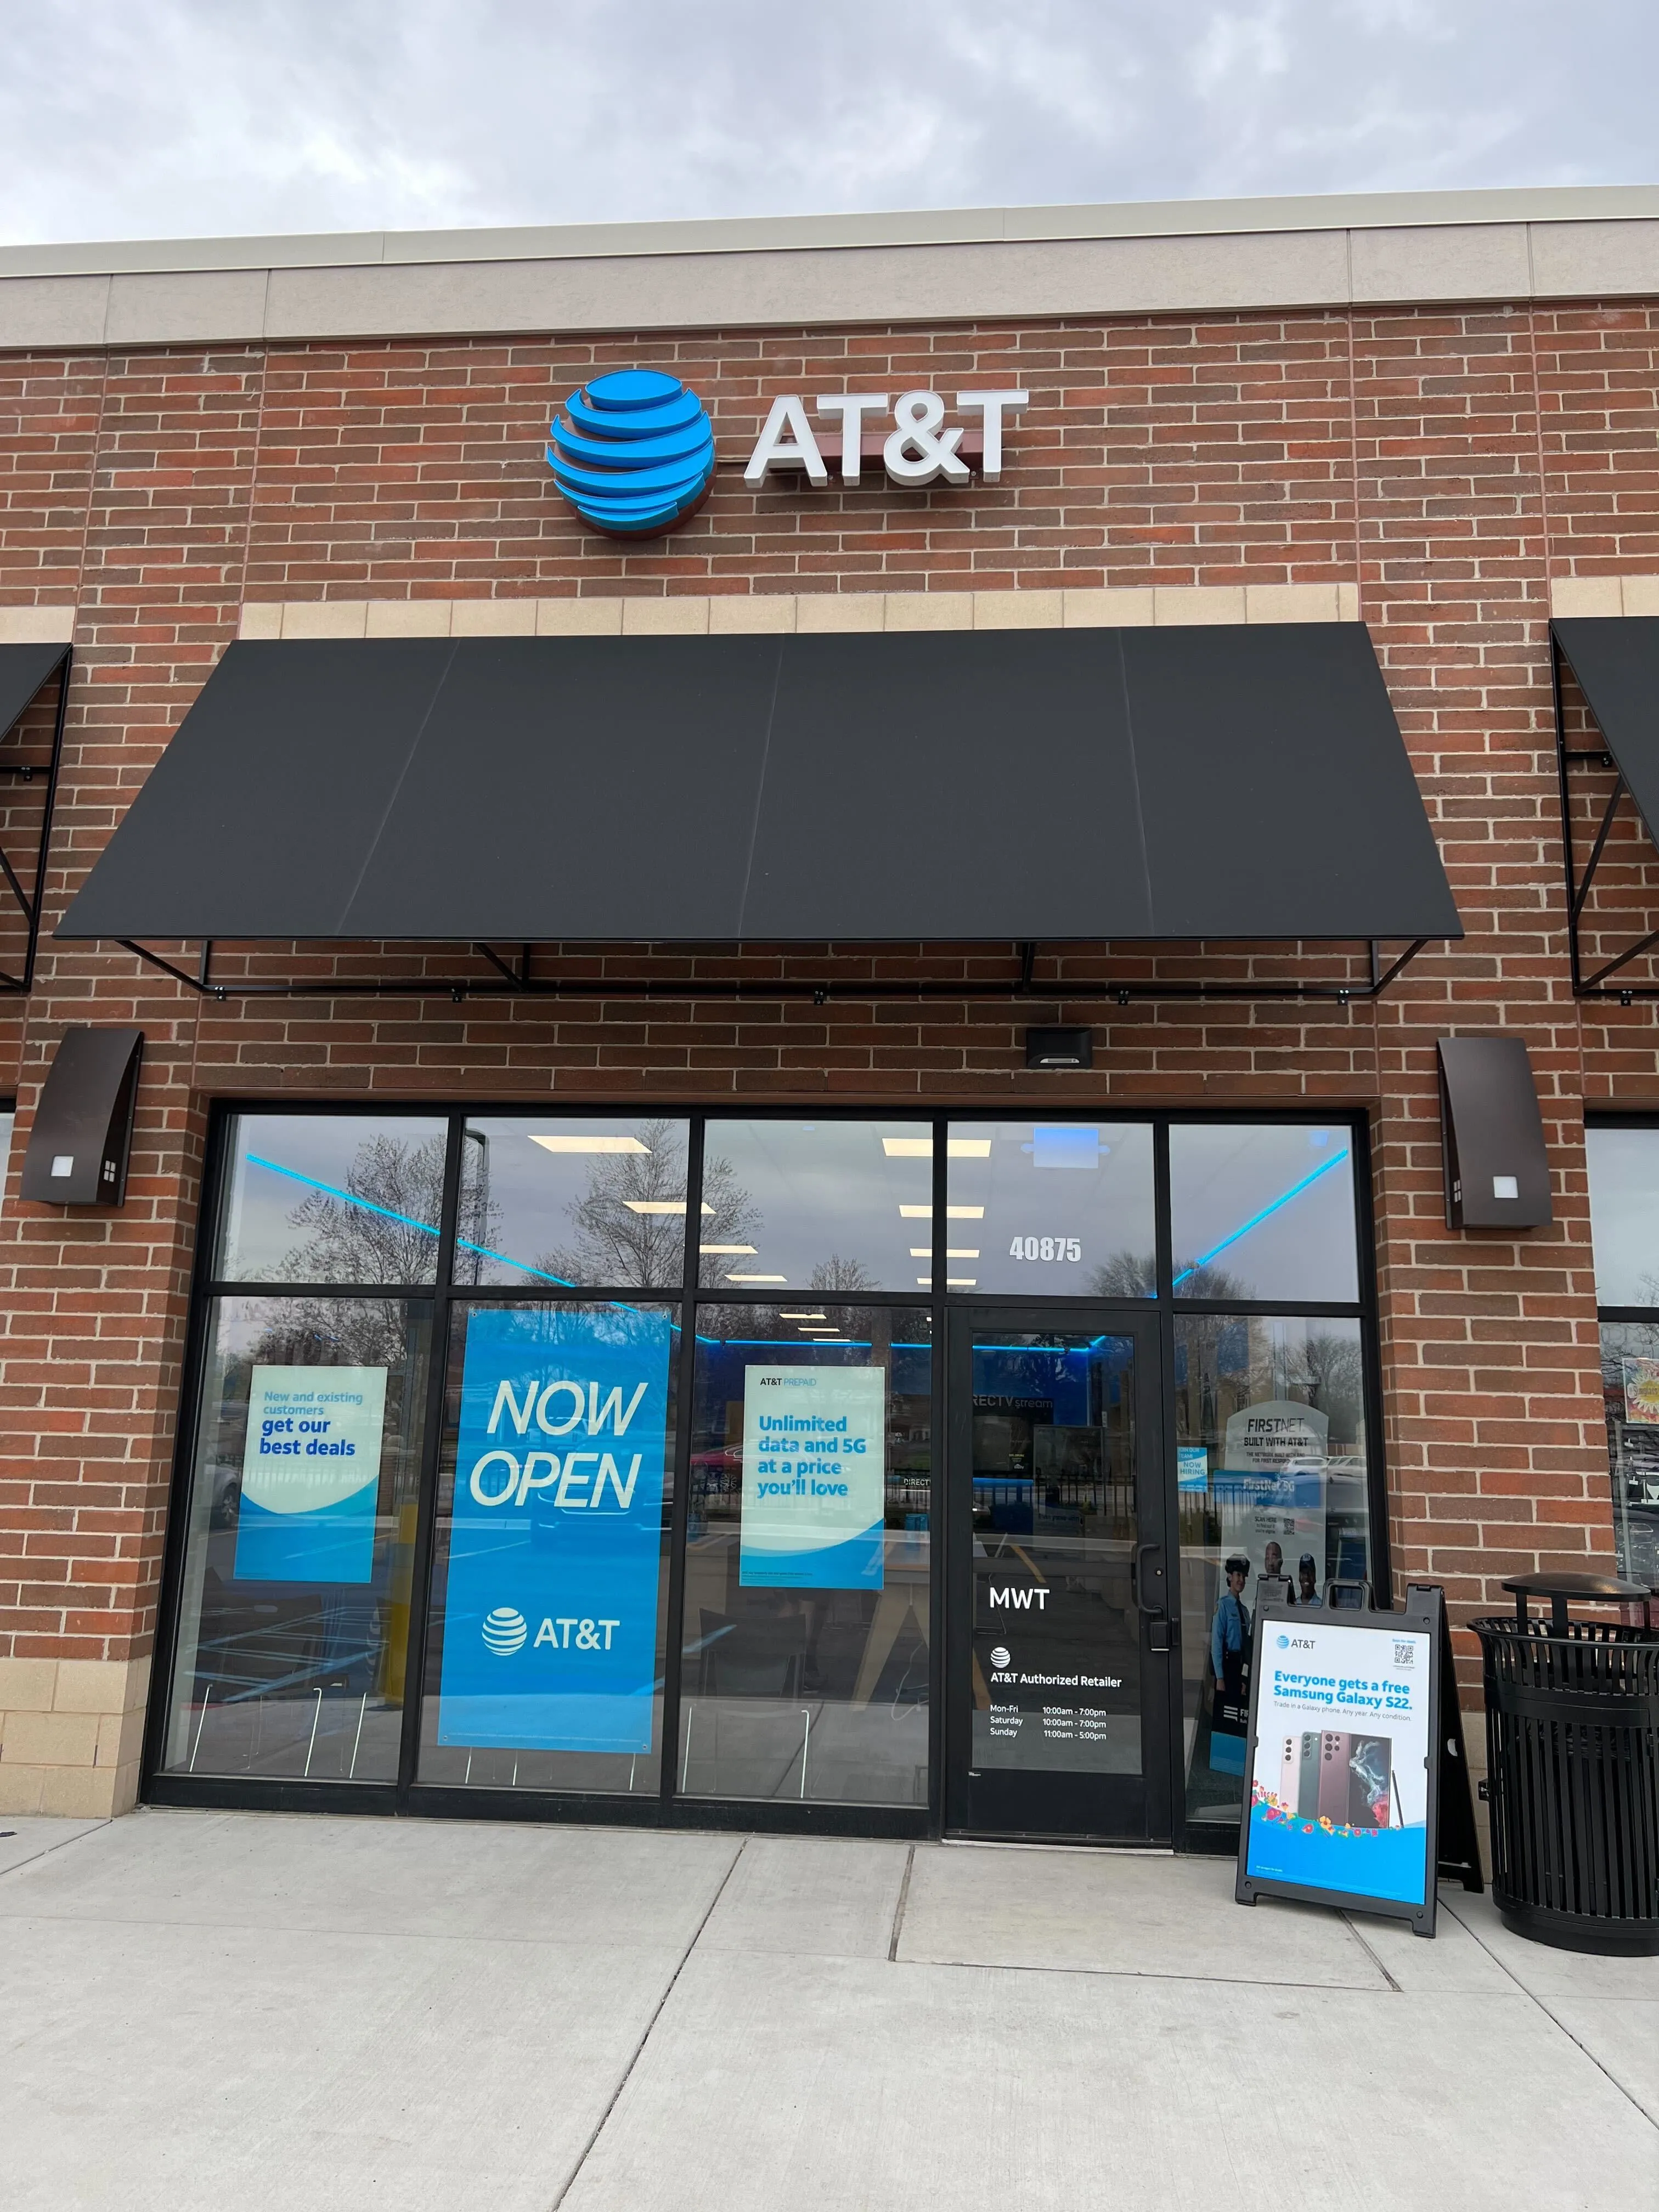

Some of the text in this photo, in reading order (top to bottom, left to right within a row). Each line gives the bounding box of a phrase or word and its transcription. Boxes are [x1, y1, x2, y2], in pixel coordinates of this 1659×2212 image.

[743, 388, 1029, 488] AT&T
[1009, 1237, 1081, 1262] 40875
[760, 1378, 817, 1386] AT&T PREPAID
[264, 1391, 363, 1405] New and existing
[1015, 1399, 1053, 1408] stream
[263, 1405, 324, 1415] customers
[486, 1380, 648, 1436] NOW
[262, 1418, 331, 1436] get our
[759, 1415, 847, 1432] Unlimited
[1248, 1418, 1305, 1432] FIRSTNET
[259, 1438, 356, 1455] best deals
[759, 1436, 866, 1453] data and 5G
[1266, 1437, 1285, 1447] WITH
[1288, 1437, 1308, 1447] AT&T
[758, 1458, 842, 1478] at a price
[469, 1450, 642, 1509] OPEN
[757, 1479, 848, 1499] you'll love
[990, 1587, 1050, 1610] MWT
[533, 1618, 620, 1650] AT&T
[1291, 1639, 1316, 1649] AT&T
[990, 1672, 1122, 1688] AT&T Authorized Retailer
[1274, 1671, 1410, 1694] Everyone gets a free
[1273, 1685, 1413, 1709] Samsung Galaxy S22.
[990, 1705, 1019, 1713] Mon-Fri
[1042, 1707, 1073, 1715] 10:00am
[1079, 1708, 1107, 1718] 7:00pm
[1302, 1704, 1321, 1712] Galaxy
[990, 1716, 1023, 1726] Saturday
[1042, 1718, 1073, 1726] 10:00am
[1079, 1720, 1107, 1729] 7:00pm
[990, 1728, 1018, 1738] Sunday
[1043, 1730, 1073, 1739] 11:00am
[1079, 1731, 1107, 1741] 5:00pm
